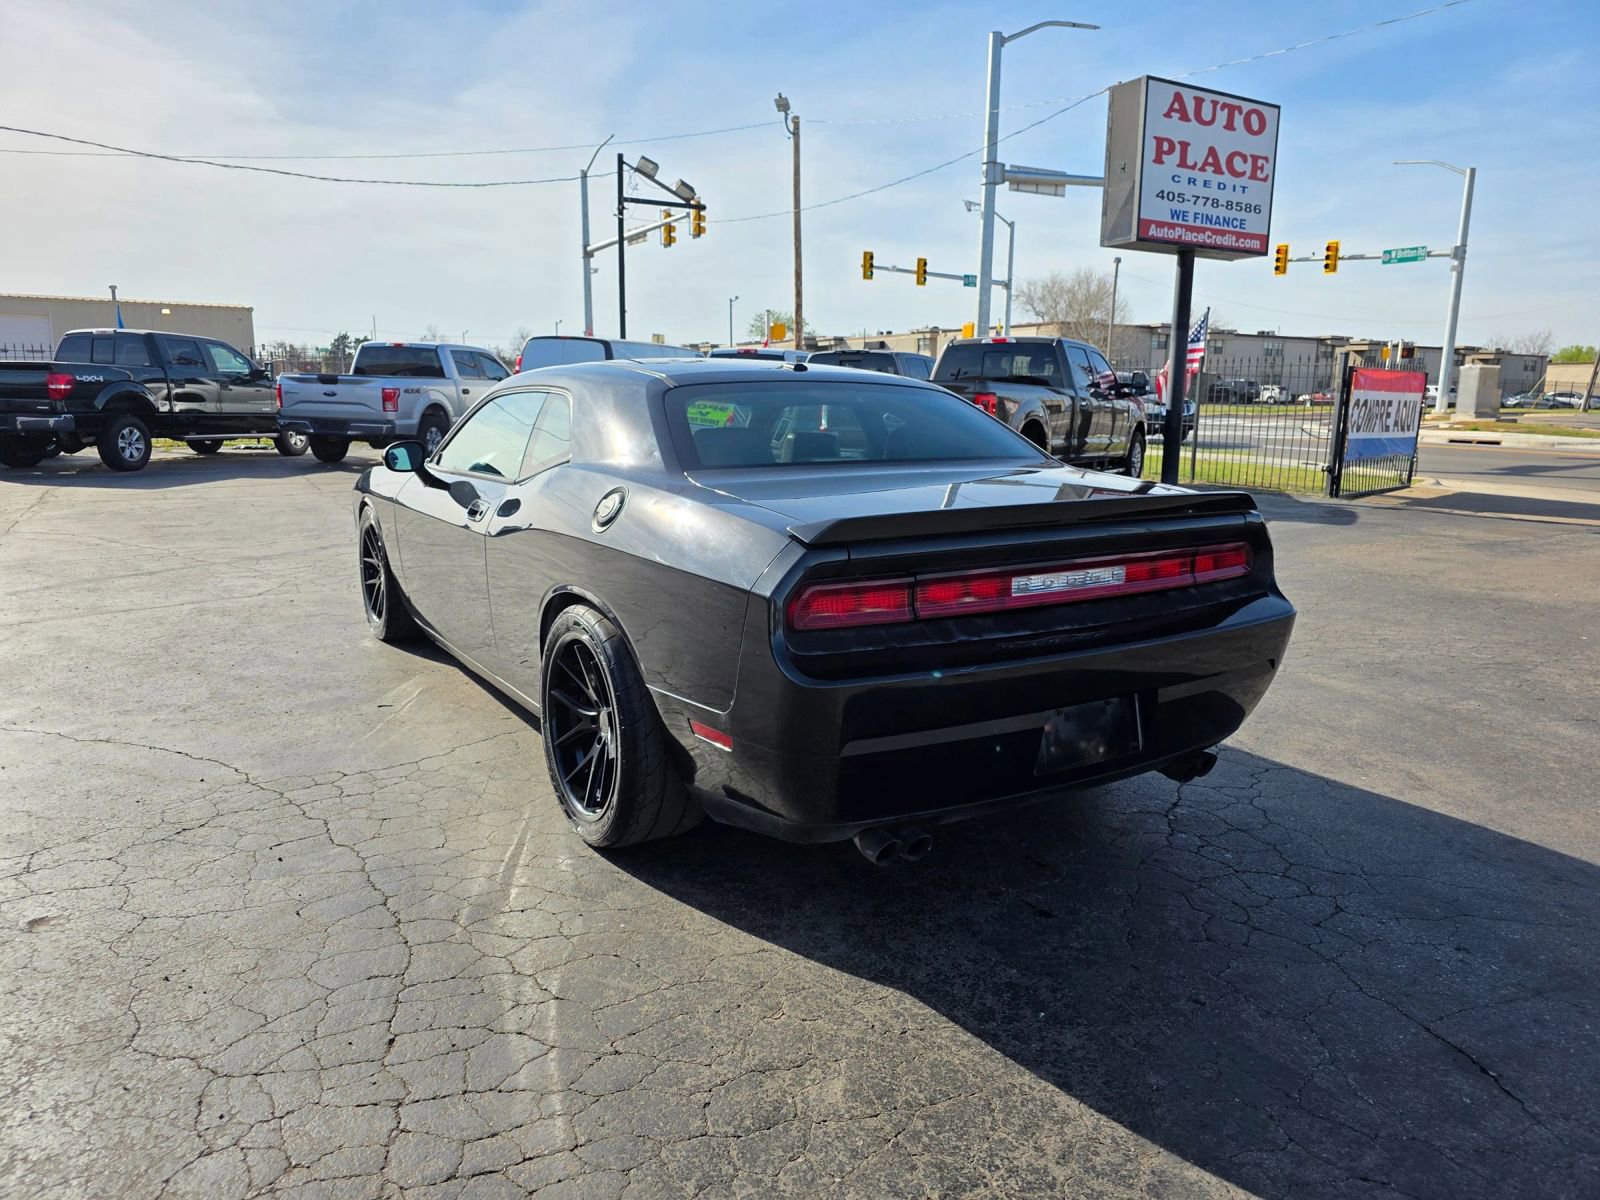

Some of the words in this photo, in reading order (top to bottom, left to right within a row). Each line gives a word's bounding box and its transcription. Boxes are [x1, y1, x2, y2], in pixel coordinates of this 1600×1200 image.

[1163, 91, 1267, 136] AUTO
[1152, 136, 1270, 183] PLACE
[1171, 174, 1249, 194] CREDIT
[1155, 189, 1262, 215] 405-778-8586
[1170, 208, 1190, 223] WE
[1193, 212, 1247, 230] FINANCE
[1148, 223, 1260, 249] AutoPlaceCredit.com
[1350, 398, 1393, 433] COMPRE
[1392, 400, 1419, 434] AQUI
[1016, 568, 1124, 593] DODGE
